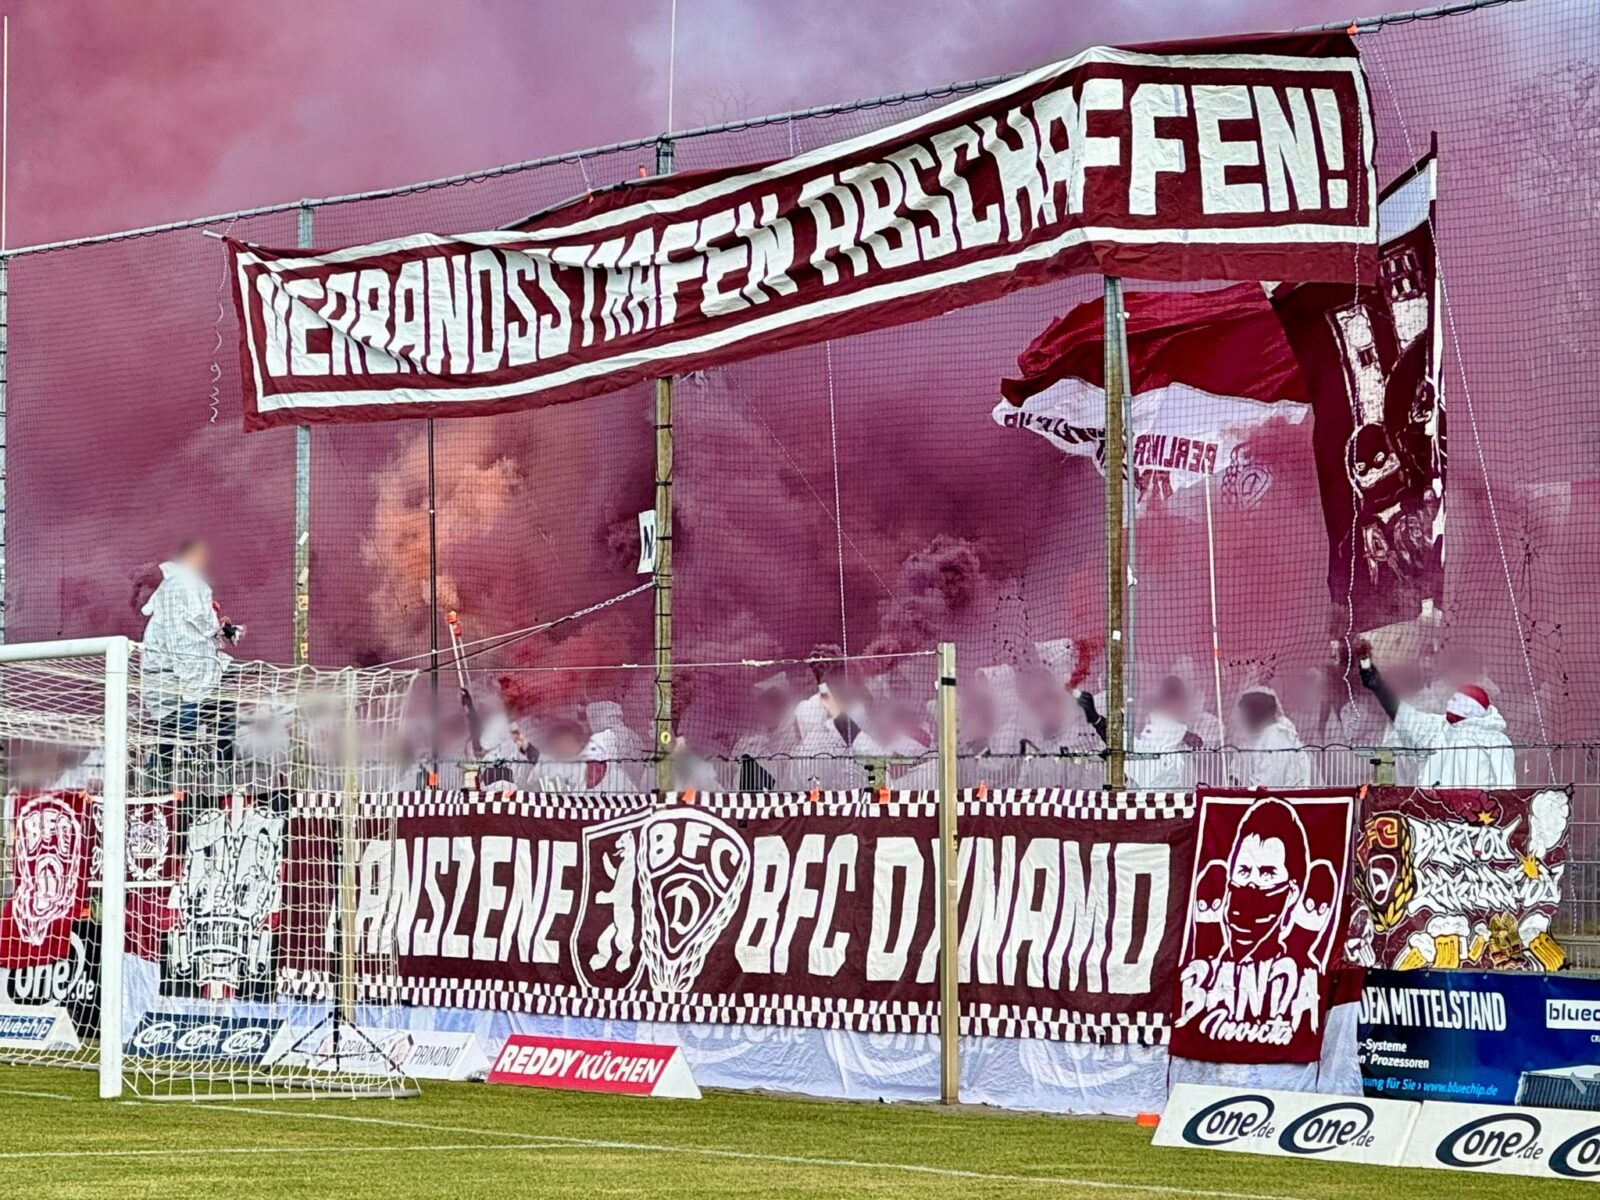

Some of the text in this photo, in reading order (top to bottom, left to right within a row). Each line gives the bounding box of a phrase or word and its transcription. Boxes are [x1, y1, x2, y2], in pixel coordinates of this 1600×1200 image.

[798, 78, 1348, 286] ABSCHAFFEN!
[649, 821, 742, 889] BFC
[664, 881, 700, 936] D
[734, 833, 859, 977] BFC
[866, 836, 1170, 994] DYNAMO
[1175, 957, 1320, 1035] BANDA
[1390, 988, 1507, 1032] MITTELSTAND
[0, 1016, 51, 1039] luechip
[575, 1050, 664, 1083] KÜCHEN
[1371, 1053, 1429, 1069] Prozessoren
[1386, 1076, 1401, 1090] für
[1402, 1078, 1416, 1091] Sie
[1423, 1081, 1498, 1097] www.bluechip.de
[1206, 1110, 1375, 1147] one.de one.de
[1463, 1129, 1544, 1160] one.de
